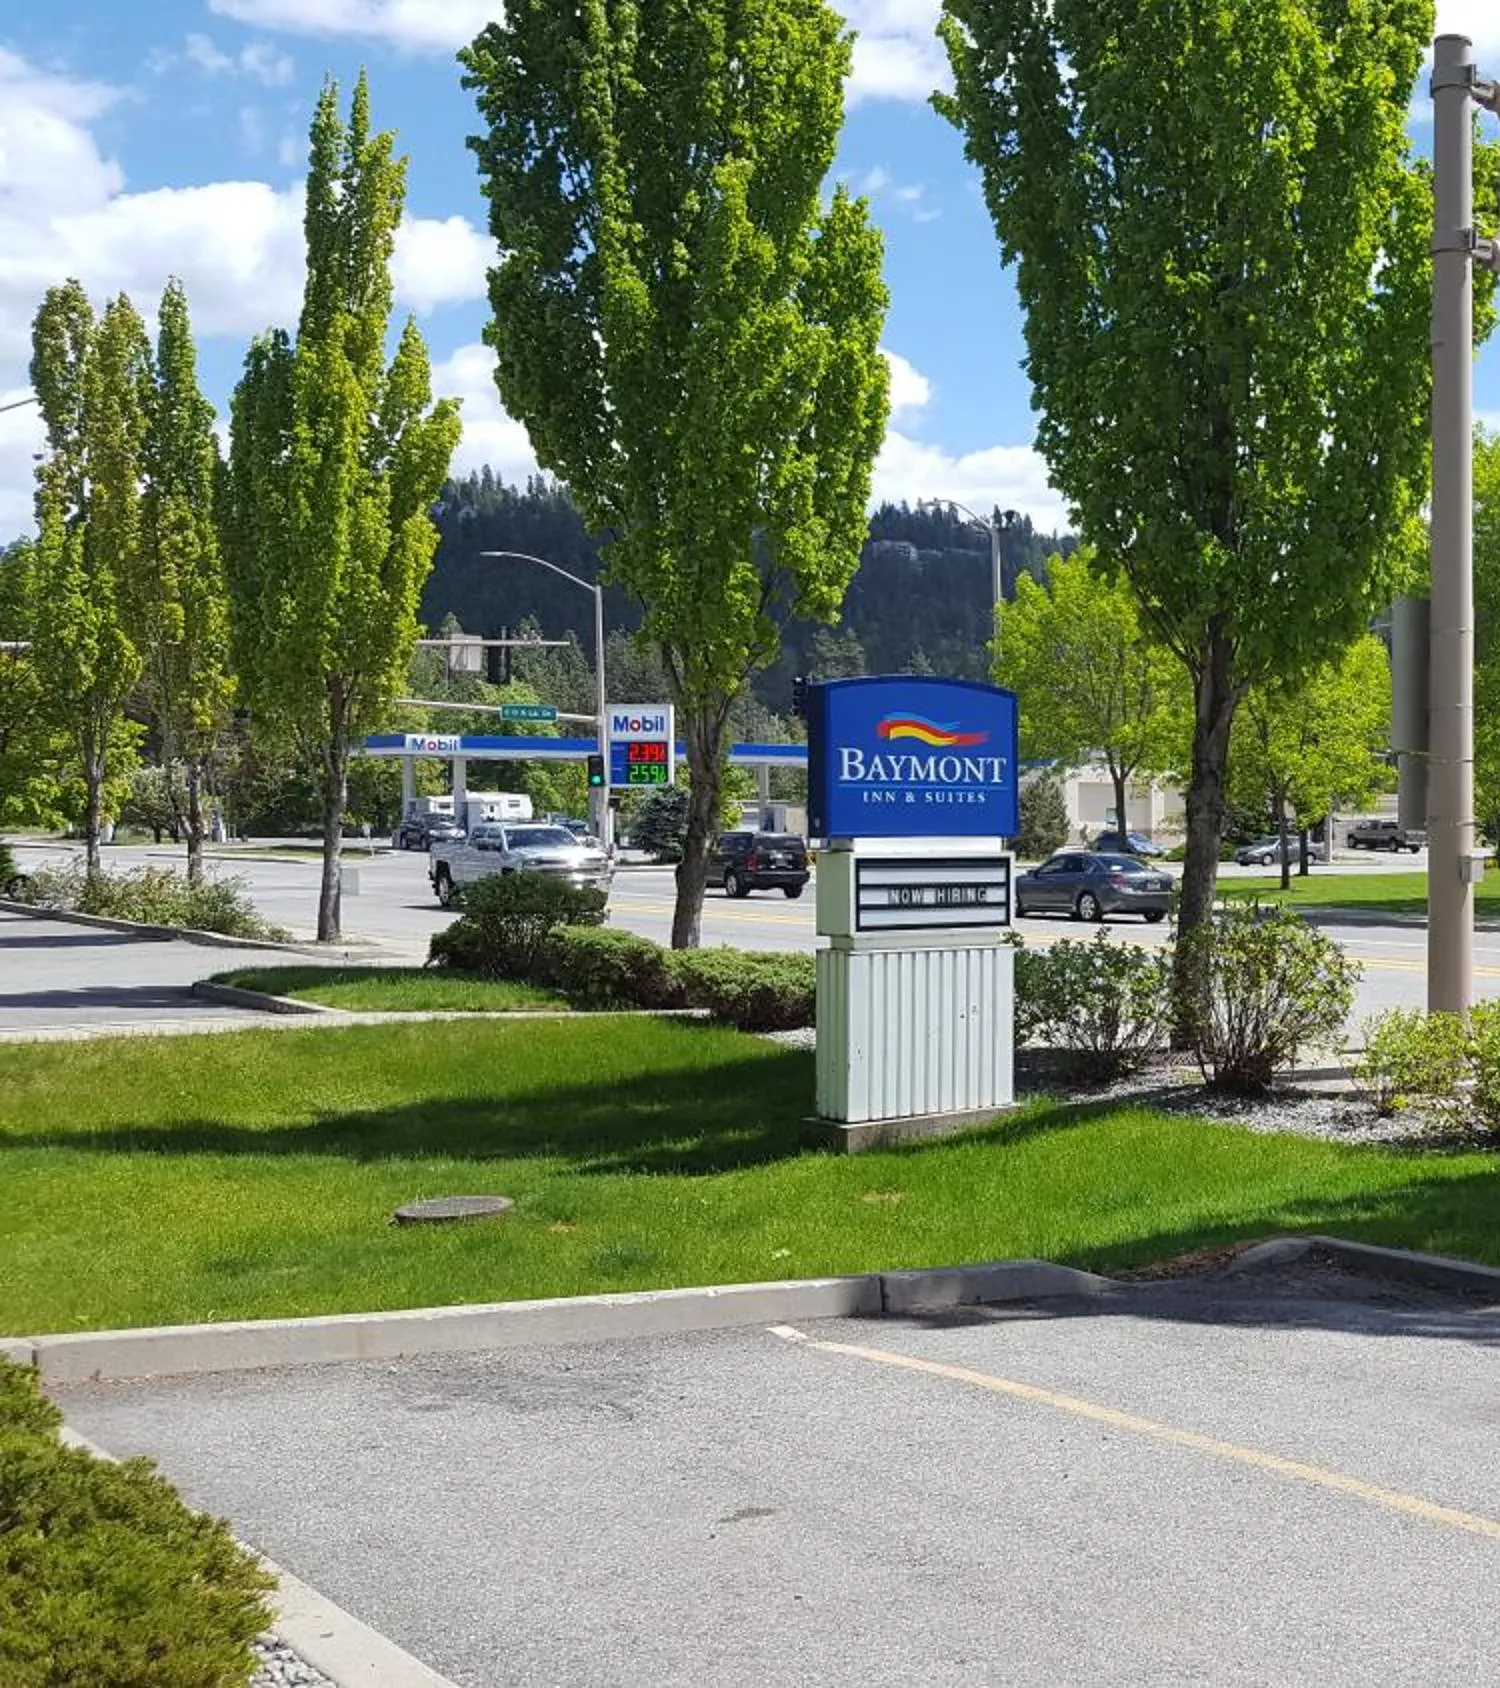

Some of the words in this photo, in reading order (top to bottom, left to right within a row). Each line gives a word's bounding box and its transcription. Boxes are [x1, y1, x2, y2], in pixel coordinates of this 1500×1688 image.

[613, 715, 665, 732] Mobil
[411, 737, 457, 751] Mobil
[839, 748, 1007, 783] BAYMONT
[863, 791, 897, 803] INN
[905, 791, 916, 803] &
[925, 791, 986, 803] SUITES
[890, 888, 922, 904] NOW
[937, 887, 988, 903] HIRING
